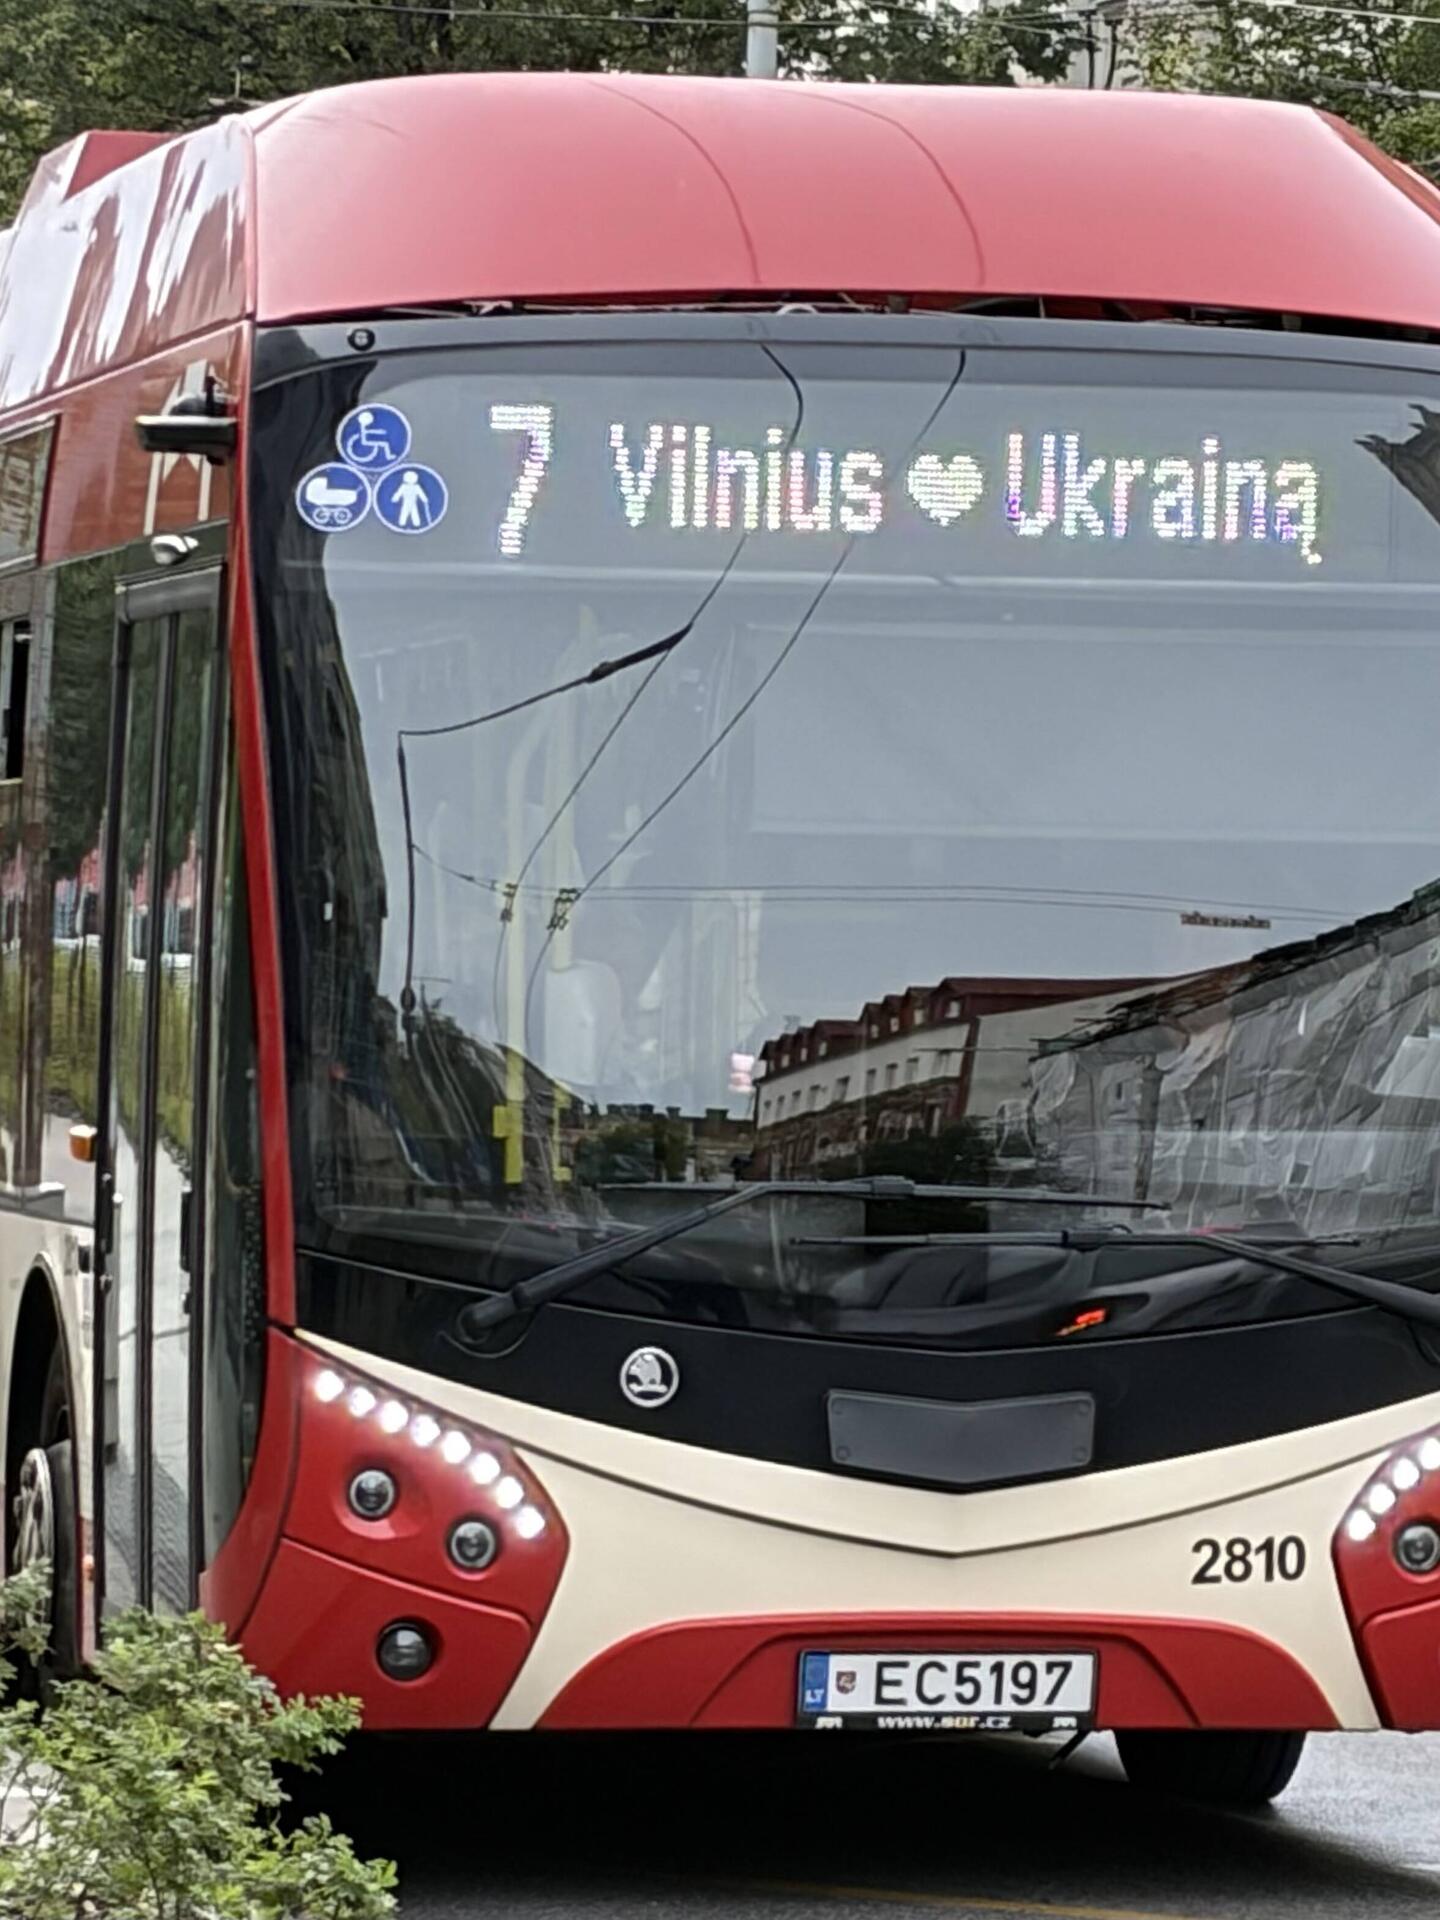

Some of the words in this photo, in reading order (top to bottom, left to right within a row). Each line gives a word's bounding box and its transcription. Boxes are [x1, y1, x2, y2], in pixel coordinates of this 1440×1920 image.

[489, 404, 554, 556] 7
[609, 423, 885, 533] Vilnius
[1006, 431, 1322, 565] Ukrainą
[1191, 1535, 1306, 1584] 2810
[804, 1688, 824, 1703] LT
[874, 1660, 1073, 1706] EC5197
